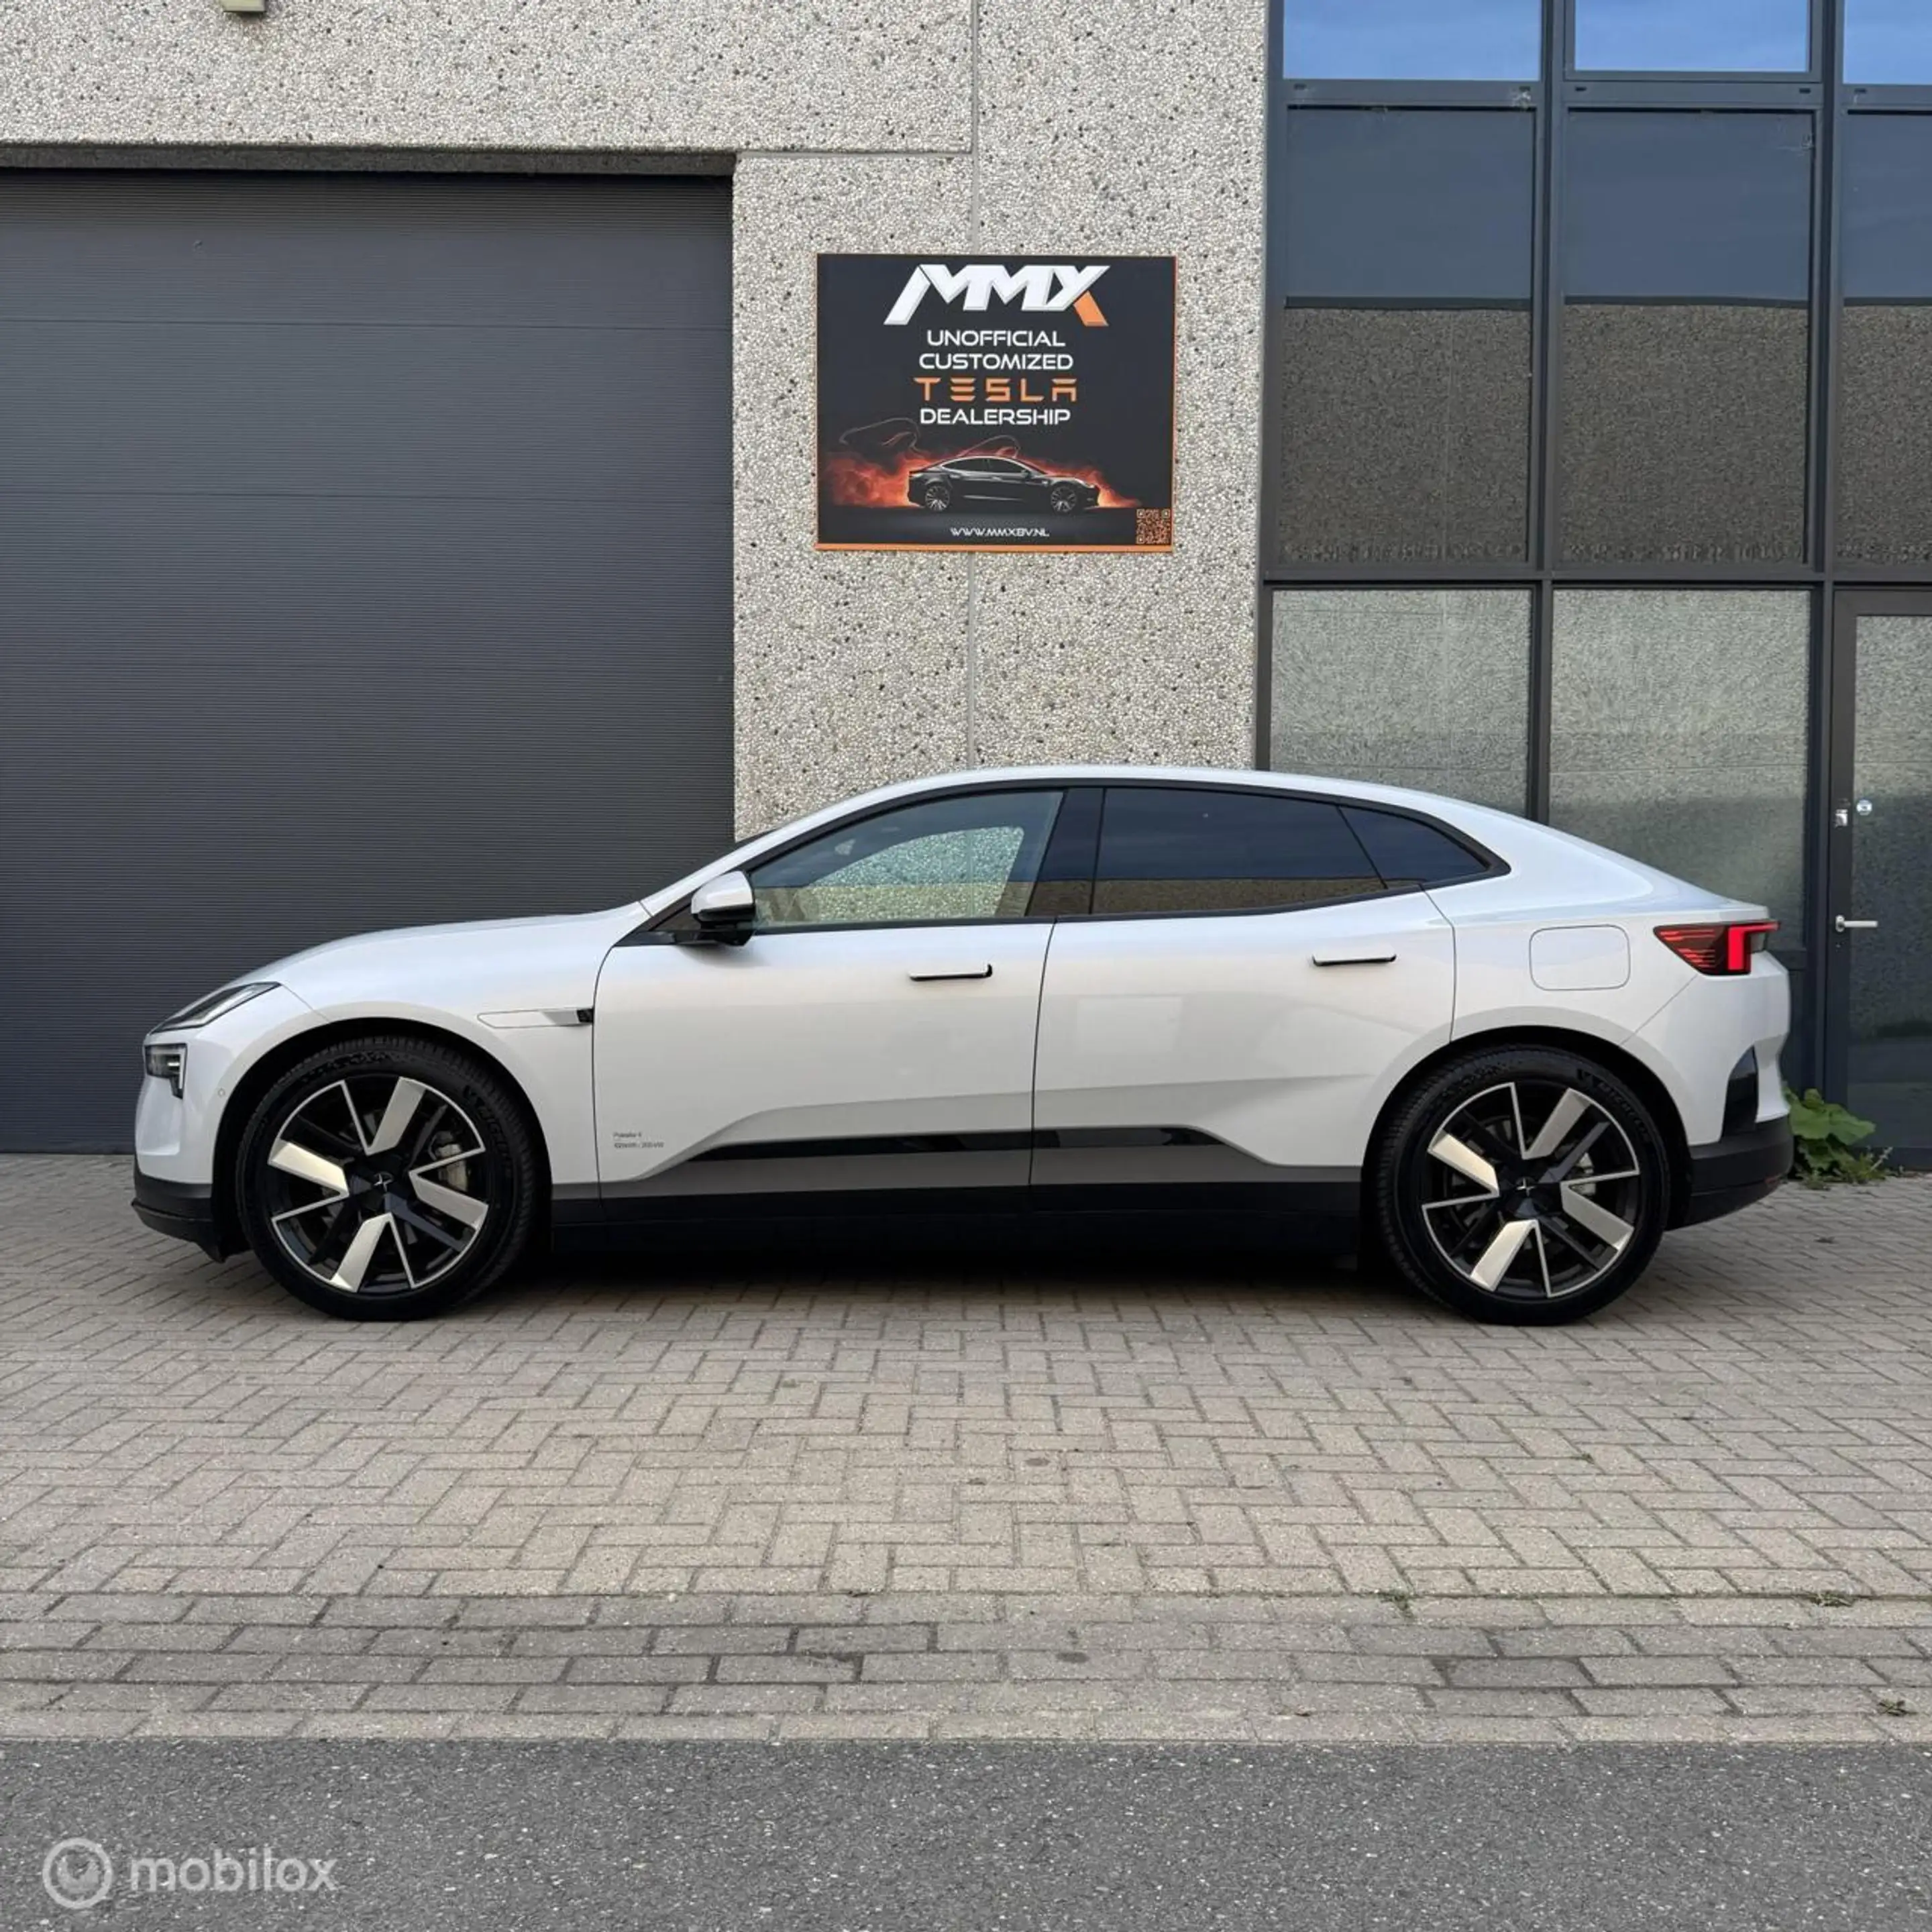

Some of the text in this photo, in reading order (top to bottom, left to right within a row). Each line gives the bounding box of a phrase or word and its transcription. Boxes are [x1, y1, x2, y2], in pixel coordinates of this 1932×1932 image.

[883, 264, 1110, 326] MMX
[926, 329, 1065, 347] UNOFFICIAL
[918, 353, 1073, 370] CUSTOMIZED
[914, 377, 1077, 402] TESLA
[920, 408, 1071, 425] DEALERSHIP
